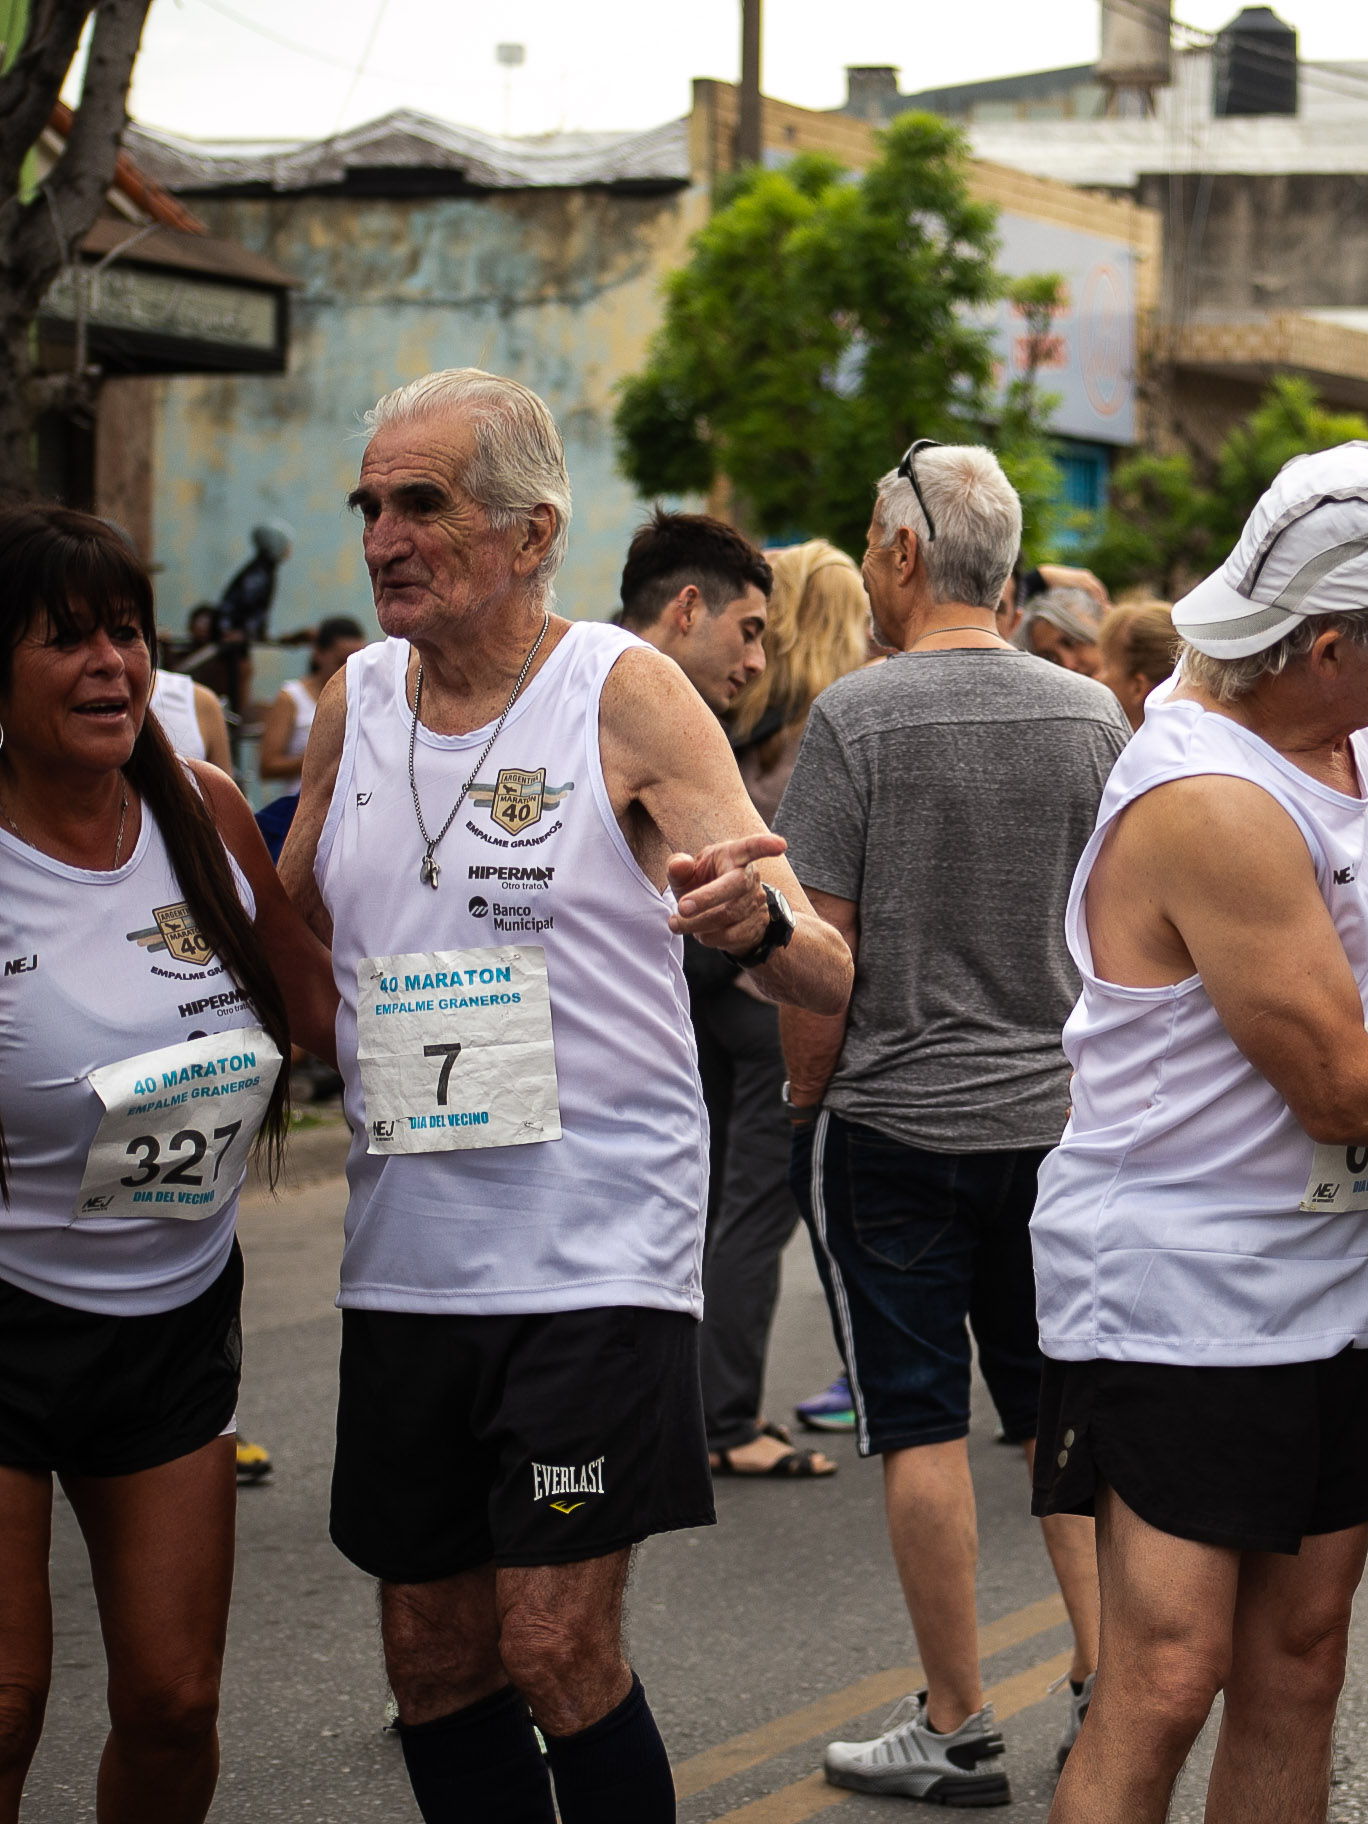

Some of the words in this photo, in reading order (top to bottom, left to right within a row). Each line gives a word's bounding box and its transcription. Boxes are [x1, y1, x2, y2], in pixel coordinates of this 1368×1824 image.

[356, 791, 373, 807] EJ
[502, 803, 531, 823] 40
[465, 820, 509, 848] EMPALME
[511, 820, 563, 848] GRANEROS
[501, 881, 520, 890] Otro
[492, 903, 532, 917] Banco
[493, 916, 554, 934] Municipal
[180, 933, 210, 956] 40
[4, 954, 38, 977] NEJ
[150, 966, 207, 980] EMPALME
[379, 976, 398, 993] 40
[404, 965, 511, 992] MARATON
[216, 1006, 234, 1017] Otro
[375, 999, 434, 1016] EMPALME
[438, 992, 521, 1010] GRANEROS
[133, 1077, 157, 1096] 40
[162, 1052, 257, 1088] MARATON
[423, 1042, 462, 1106] 7
[127, 1092, 188, 1116] EMPALME
[191, 1076, 260, 1100] GRANEROS
[373, 1120, 395, 1137] NEJ
[410, 1116, 427, 1130] DIA
[429, 1114, 446, 1129] DEL
[448, 1111, 489, 1128] VECINO
[120, 1119, 243, 1188] 327
[132, 1190, 154, 1203] DIA
[155, 1190, 177, 1203] DEL
[178, 1189, 215, 1206] VECINO
[1312, 1183, 1340, 1198] NEJ
[531, 1455, 605, 1501] EVERLAST
